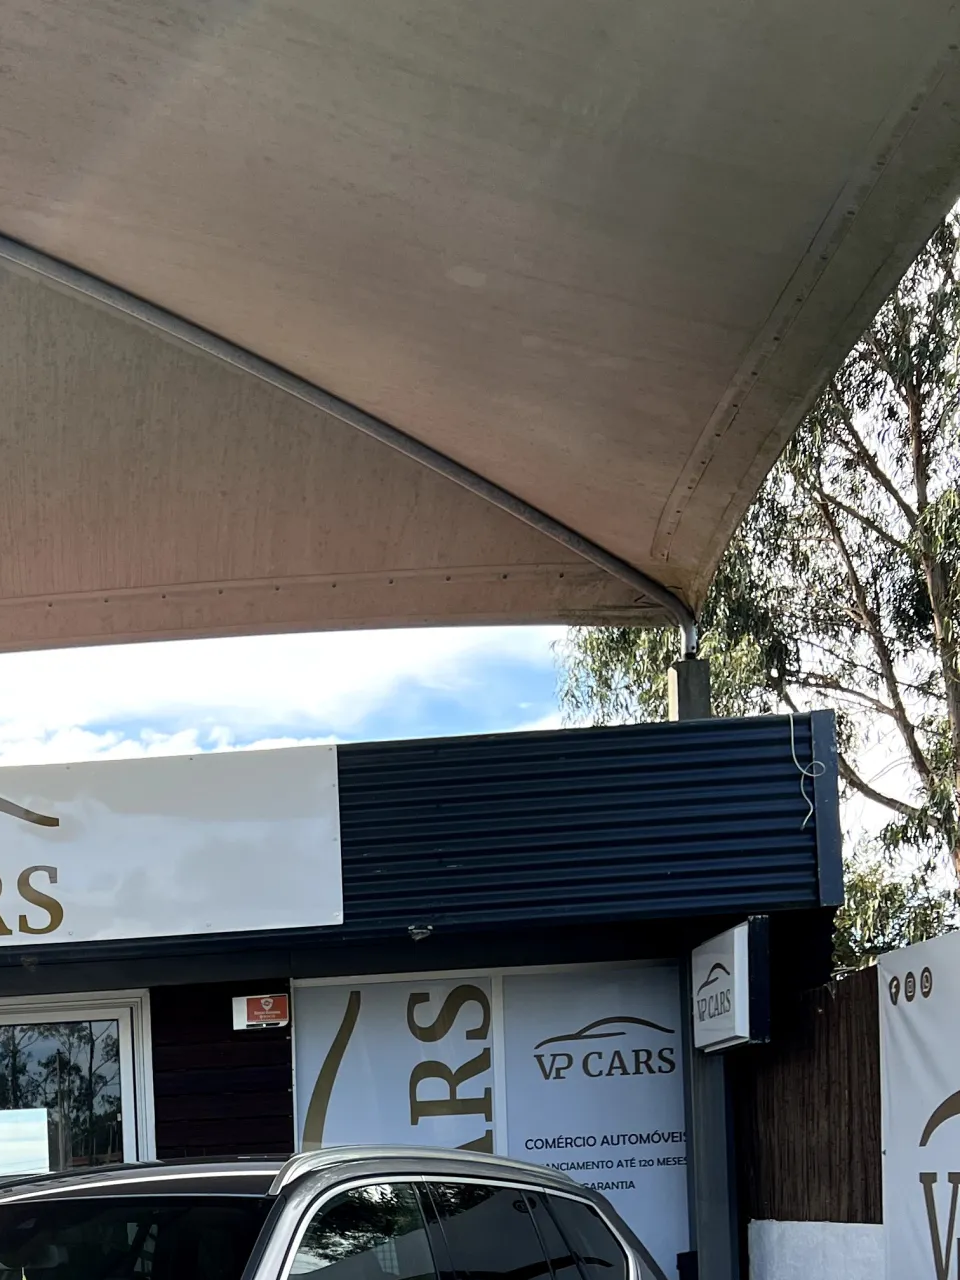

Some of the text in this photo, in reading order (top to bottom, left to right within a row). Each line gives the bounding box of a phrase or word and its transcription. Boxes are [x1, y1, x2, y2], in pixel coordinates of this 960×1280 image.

[708, 988, 731, 1018] CARS
[407, 984, 494, 1154] RS
[533, 1047, 676, 1080] VP CARS
[525, 1134, 597, 1150] COMÉRCIO
[541, 1159, 614, 1172] NCIAMENTO
[616, 1157, 636, 1169] ATÉ
[639, 1158, 654, 1168] 120
